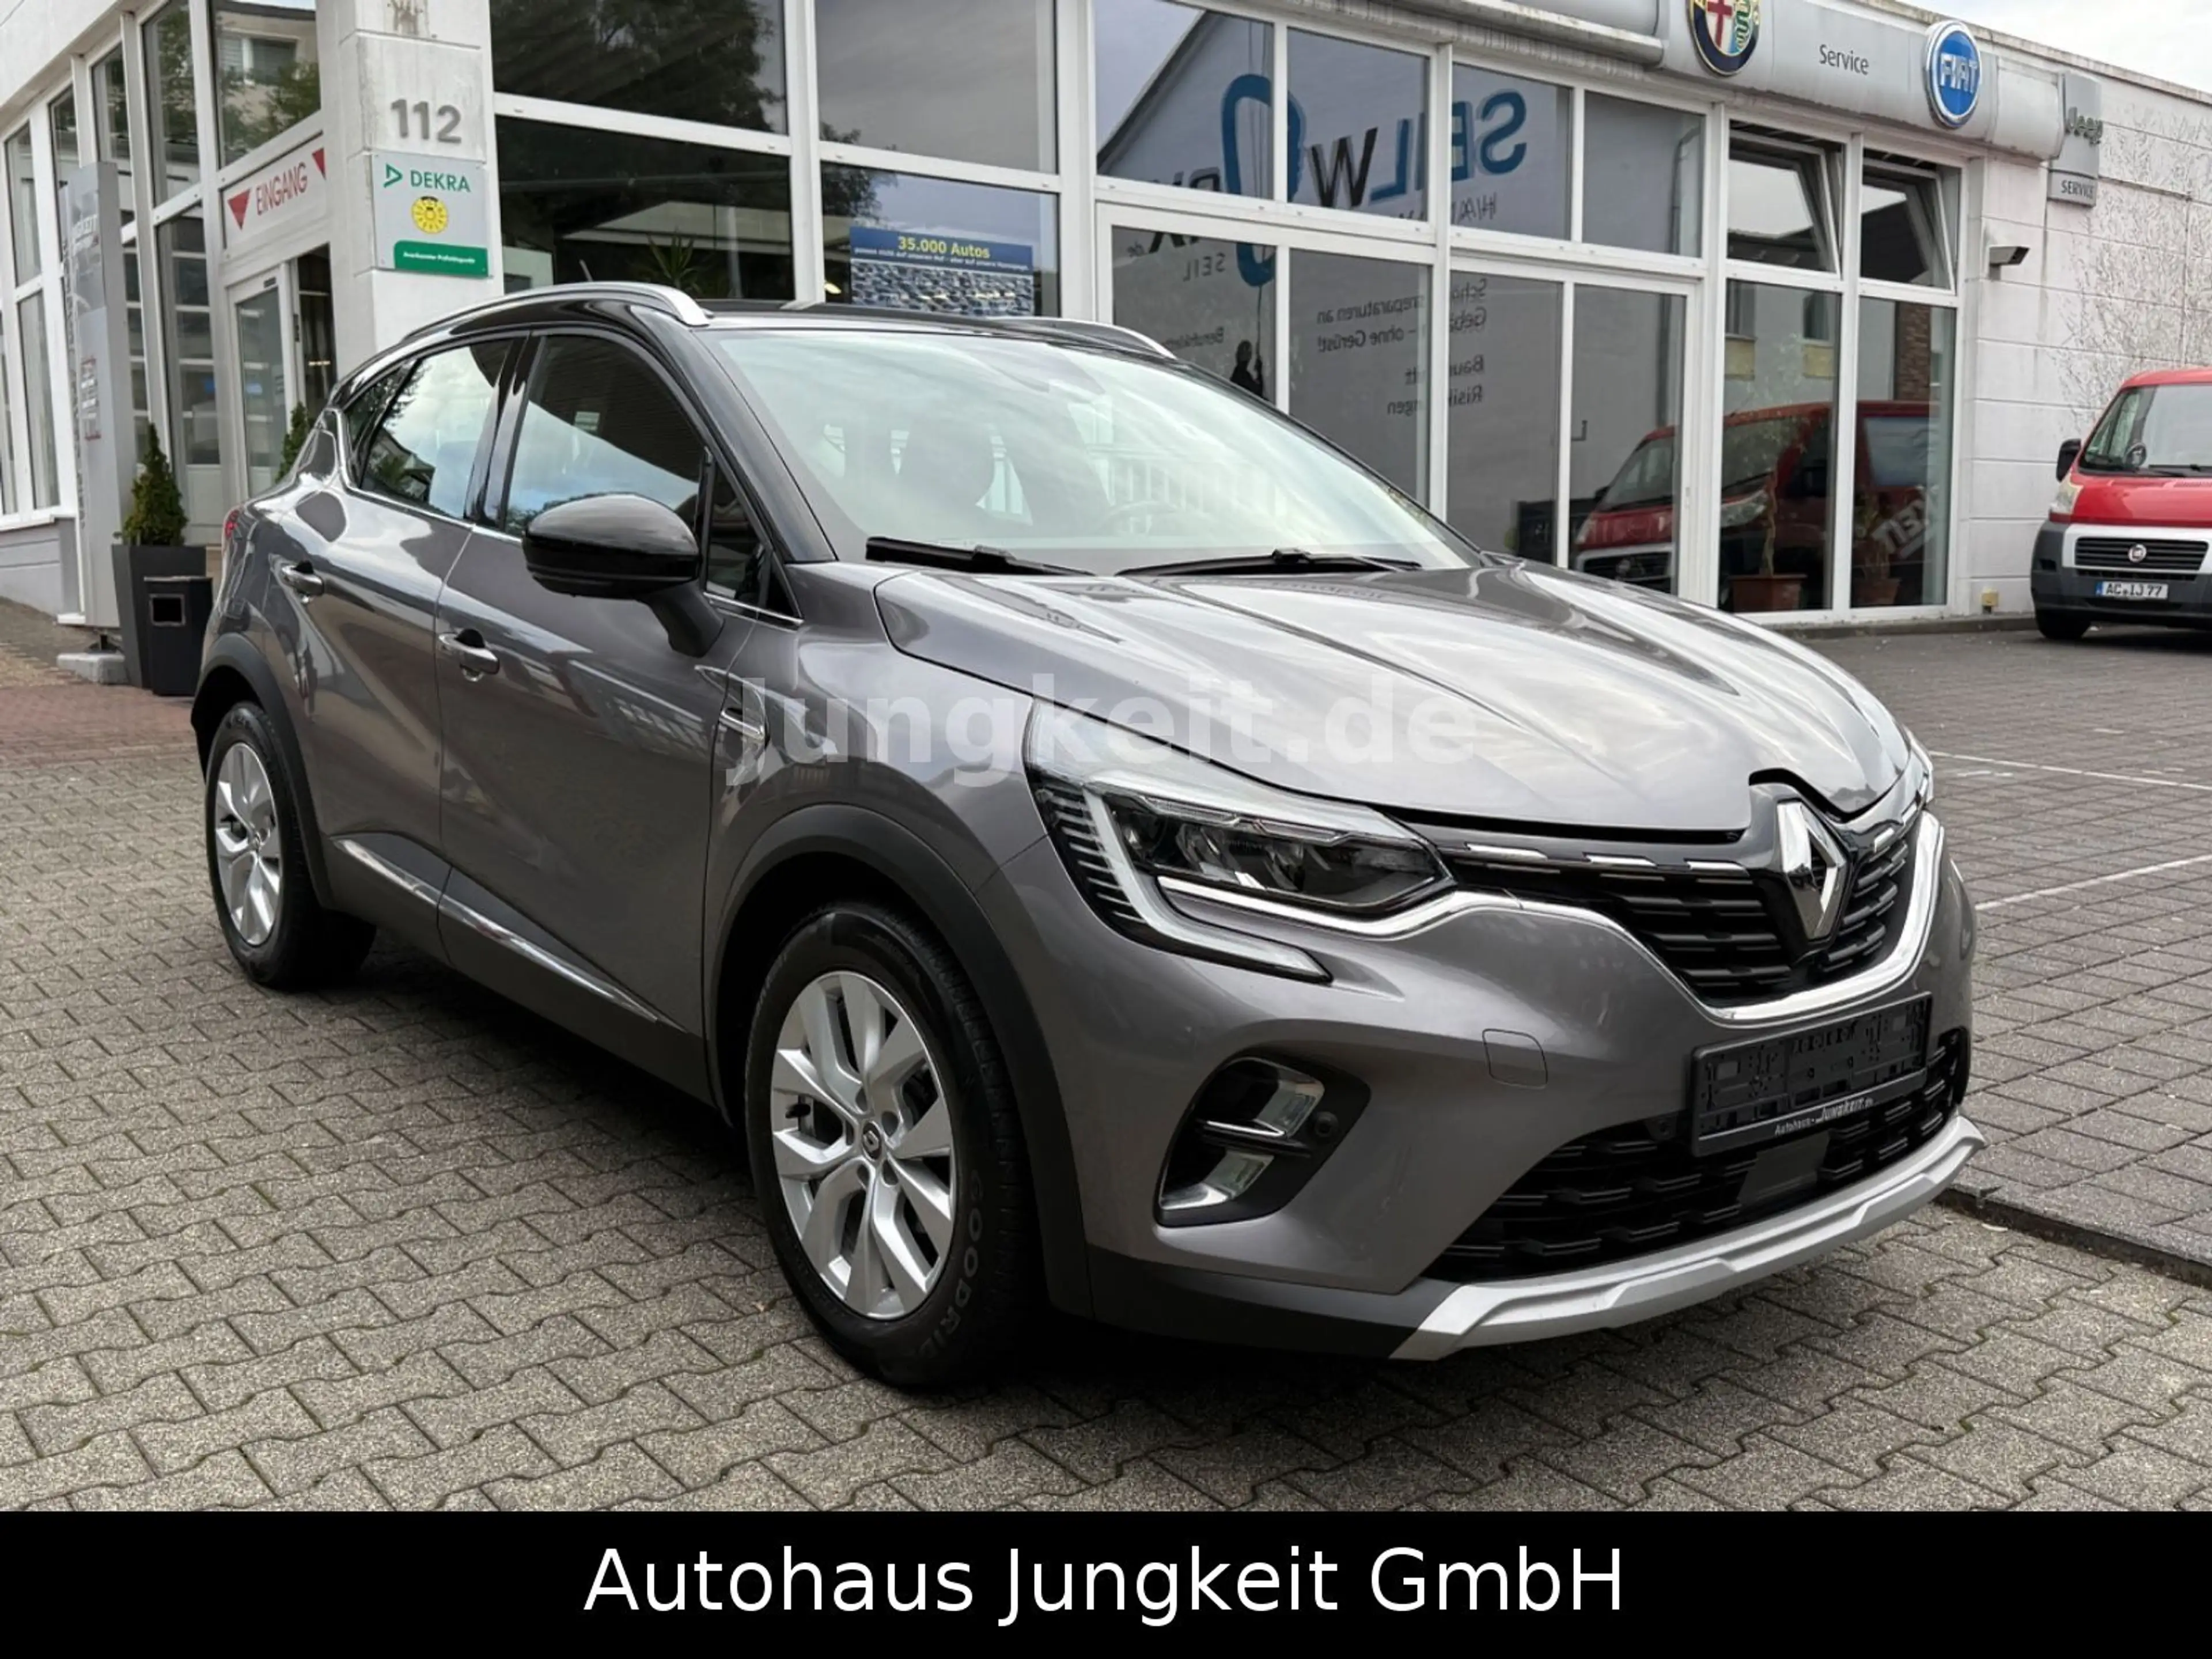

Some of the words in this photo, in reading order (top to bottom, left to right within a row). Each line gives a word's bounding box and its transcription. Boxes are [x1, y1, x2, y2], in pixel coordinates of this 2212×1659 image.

[1819, 44, 1869, 75] Service
[1940, 53, 1978, 94] FIAT
[391, 99, 462, 143] 112
[2065, 106, 2104, 145] Jeep
[256, 161, 308, 216] EINGANG
[410, 169, 471, 192] DEKRA
[2061, 180, 2094, 199] SERVICE
[898, 236, 947, 254] 35.000
[951, 243, 991, 259] Autos
[2105, 584, 2122, 596] AC
[2147, 585, 2162, 597] 77
